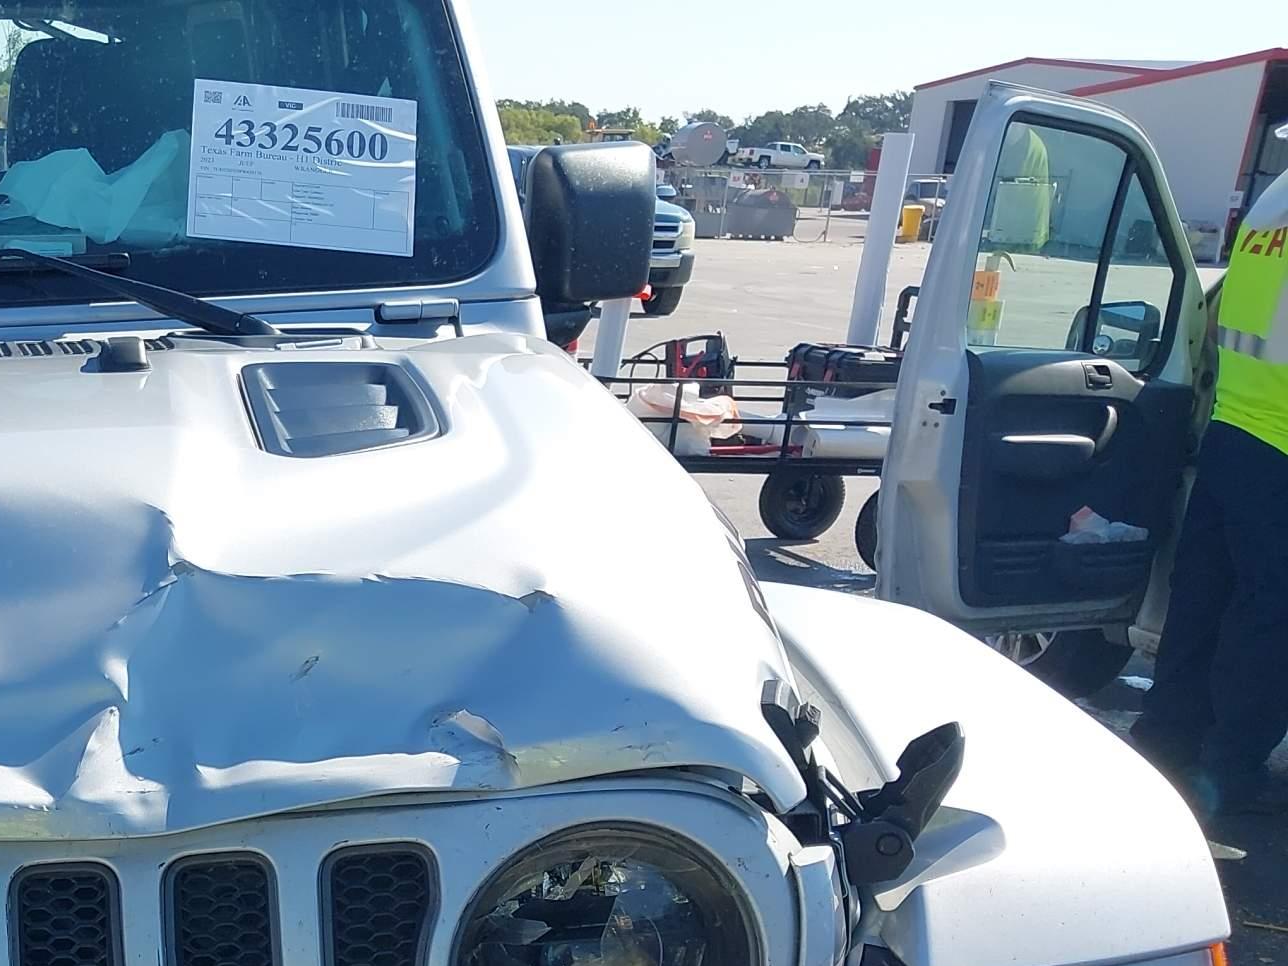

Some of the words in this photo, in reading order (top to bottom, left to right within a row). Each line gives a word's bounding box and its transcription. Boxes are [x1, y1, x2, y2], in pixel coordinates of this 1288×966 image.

[200, 145, 227, 155] Texas
[230, 148, 253, 158] Farm
[256, 150, 287, 161] Bureau
[214, 118, 388, 161] 43325600
